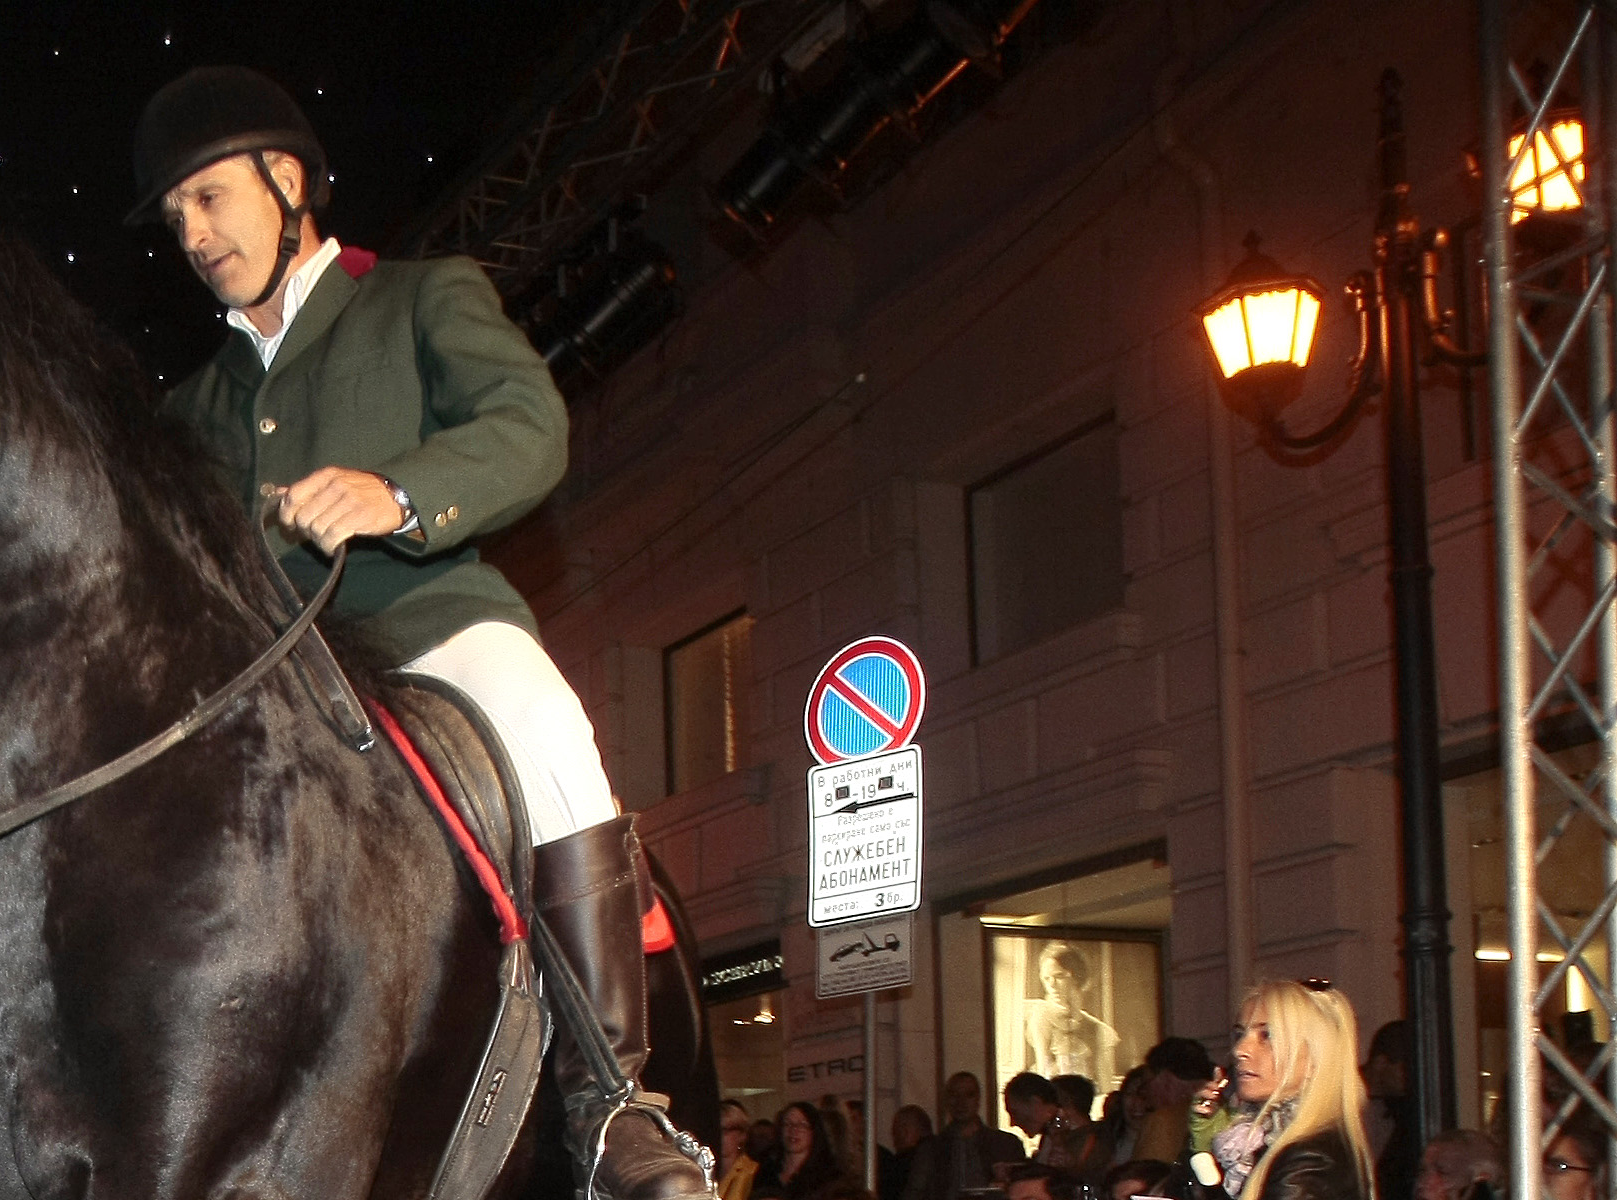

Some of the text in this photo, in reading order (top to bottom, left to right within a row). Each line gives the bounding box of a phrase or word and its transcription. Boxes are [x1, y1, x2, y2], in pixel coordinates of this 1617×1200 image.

[832, 766, 882, 787] работни
[889, 760, 913, 774] дни
[824, 835, 905, 867] СЛУЖЕБЕН
[819, 858, 911, 891] АБОНАМЕНТ
